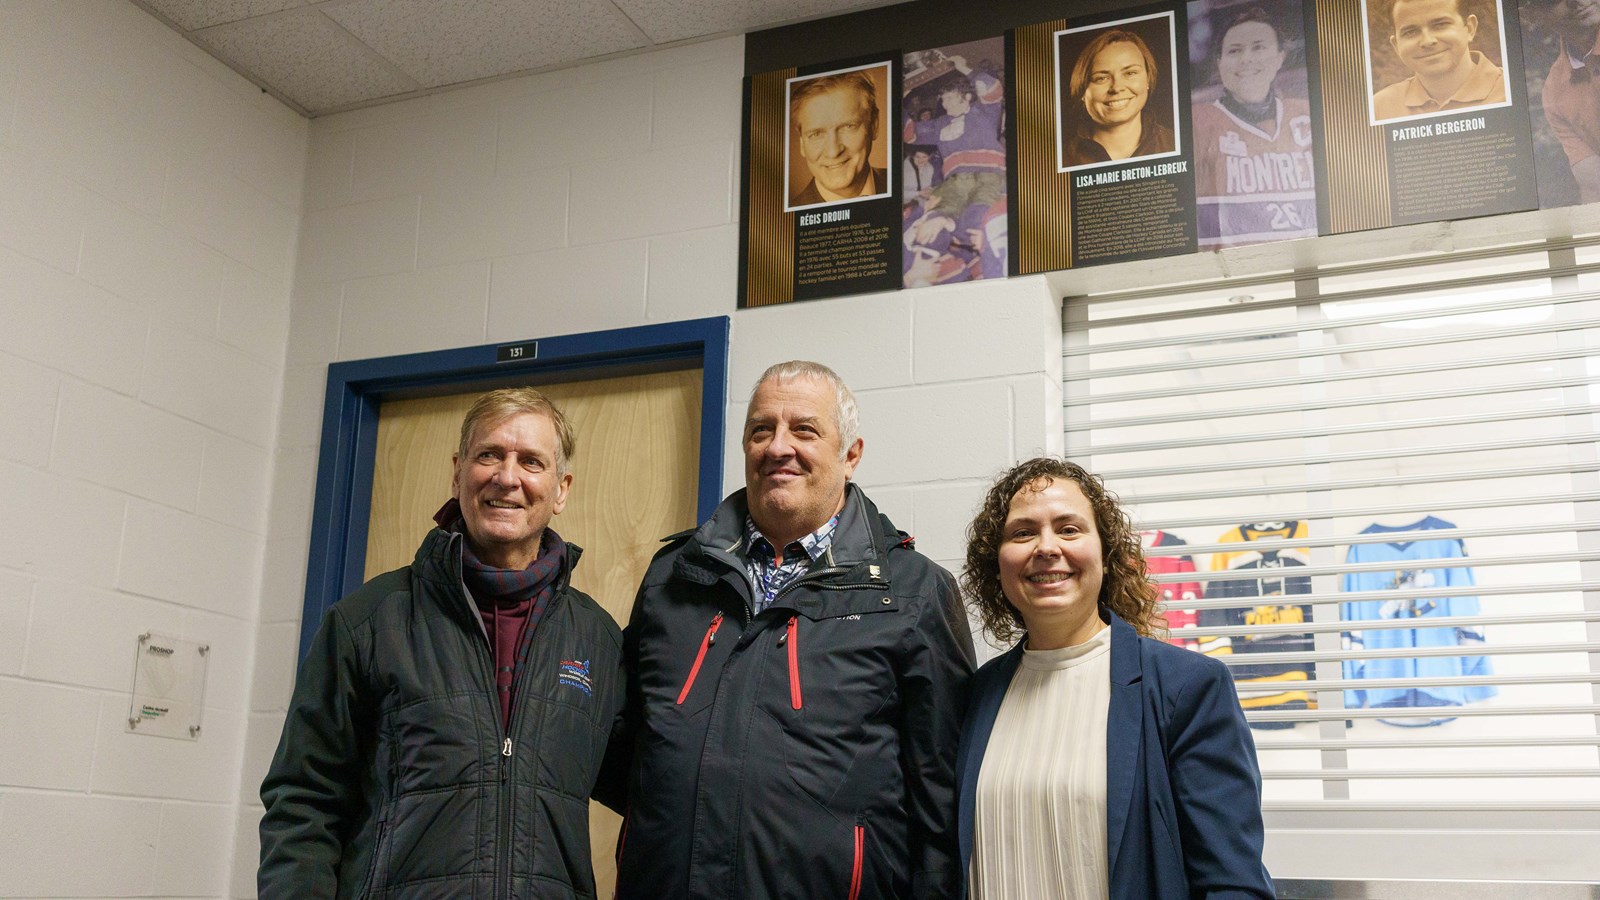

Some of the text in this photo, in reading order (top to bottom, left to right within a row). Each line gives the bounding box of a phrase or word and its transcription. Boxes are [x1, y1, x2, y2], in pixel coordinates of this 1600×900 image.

[1392, 116, 1485, 141] PATRICK BERGERON
[1077, 161, 1187, 188] LISA-MARIE BRETON-LEBREUX
[1226, 151, 1315, 193] MONTRE
[800, 209, 850, 226] RÉGIS DROUIN
[1267, 203, 1303, 230] 26
[510, 347, 523, 357] 131
[150, 646, 174, 655] PROSHOP
